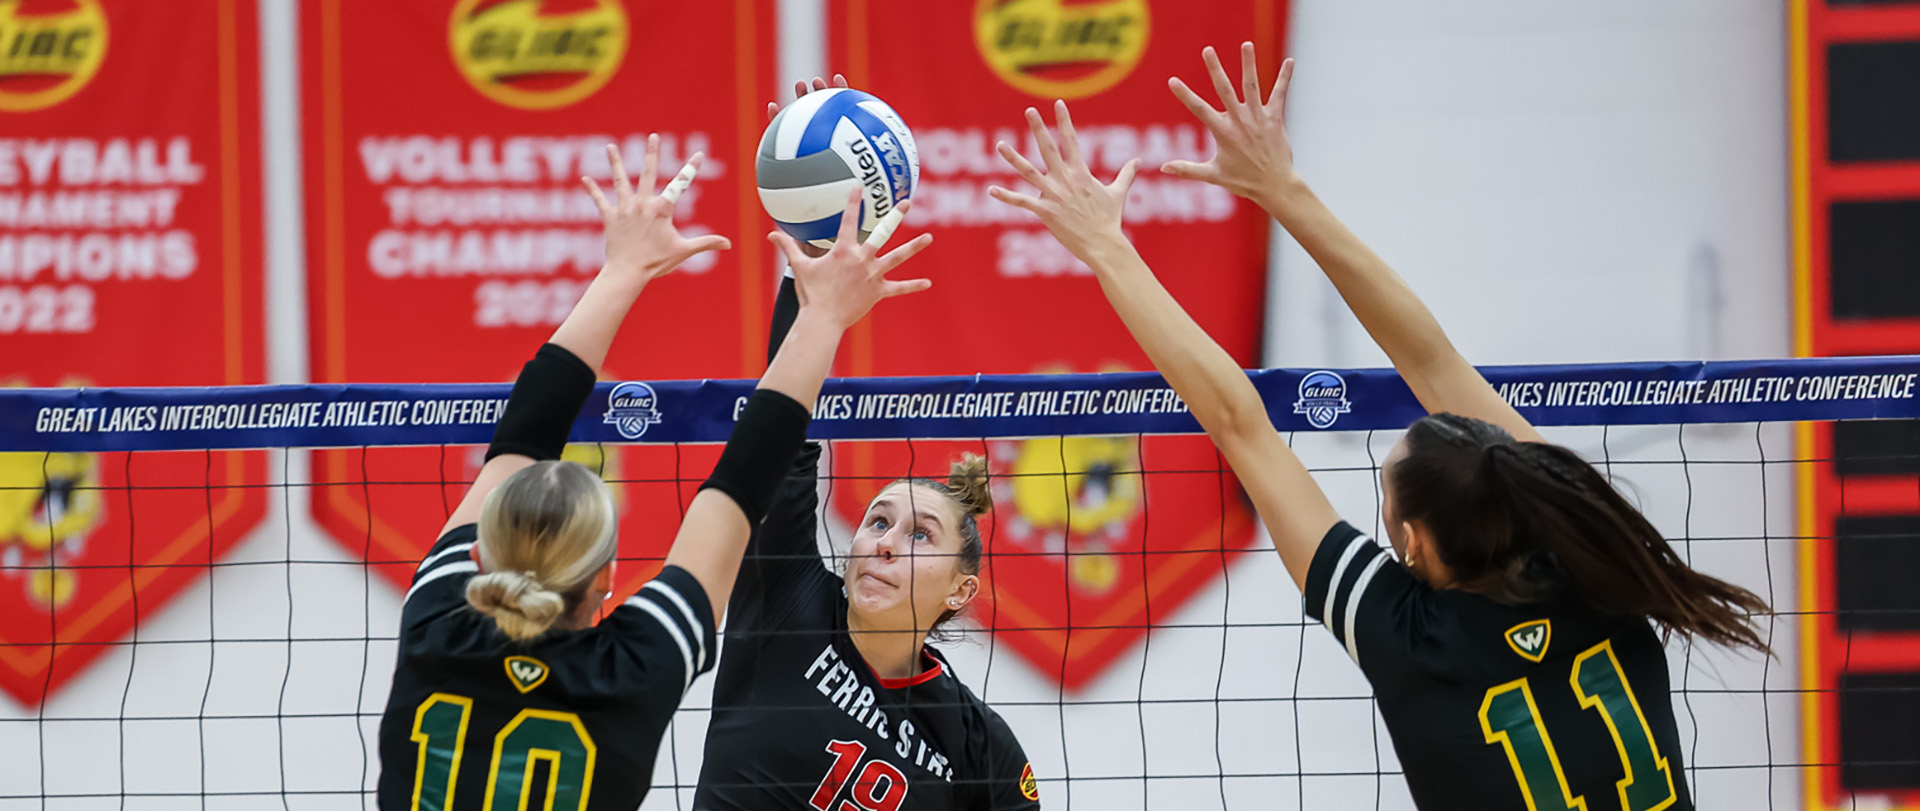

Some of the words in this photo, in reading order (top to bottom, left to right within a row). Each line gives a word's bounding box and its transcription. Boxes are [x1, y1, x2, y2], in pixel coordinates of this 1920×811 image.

[850, 138, 890, 219] molten
[870, 130, 911, 201] NCAA
[0, 230, 198, 279] PIONS
[367, 228, 719, 276] CHAMPIS
[614, 397, 652, 408] GLIAC
[855, 391, 1014, 420] INTERCOLLEGIATE
[1015, 389, 1100, 417] ATHLETIC
[1101, 388, 1189, 414] CONFERE
[1304, 387, 1342, 398] GLIAC
[1488, 382, 1544, 407] AKES
[1545, 379, 1707, 407] INTERCOLLEGIATE
[1706, 376, 1794, 405] ATHLETIC
[1795, 373, 1918, 401] CONFERENCE
[36, 407, 97, 432] GREAT
[97, 406, 157, 432] LAKES
[159, 402, 321, 431] INTERCOLLEGIATE
[322, 401, 408, 427] ATHLETIC
[1477, 638, 1677, 811] 11
[409, 692, 598, 811] 10
[809, 739, 908, 811] 19
